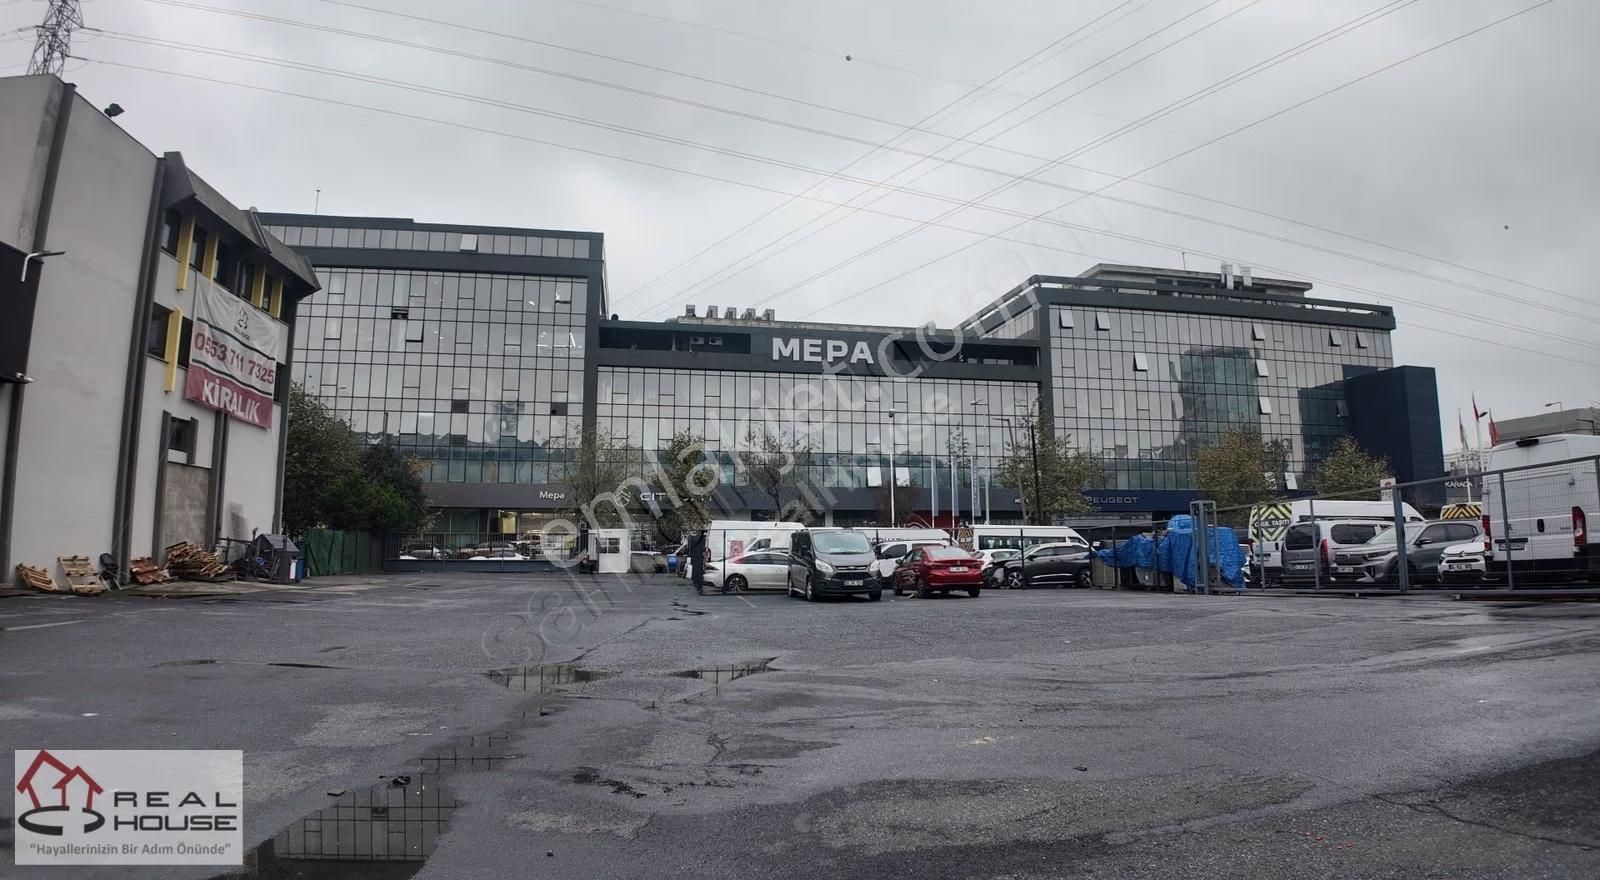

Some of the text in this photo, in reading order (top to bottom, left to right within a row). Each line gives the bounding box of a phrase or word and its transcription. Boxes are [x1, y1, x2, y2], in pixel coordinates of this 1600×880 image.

[194, 332, 228, 362] 0553
[230, 347, 245, 372] 711
[248, 359, 275, 384] 7325
[772, 338, 875, 364] MEPA
[202, 378, 260, 423] KİRALIK
[539, 490, 565, 500] Mepa
